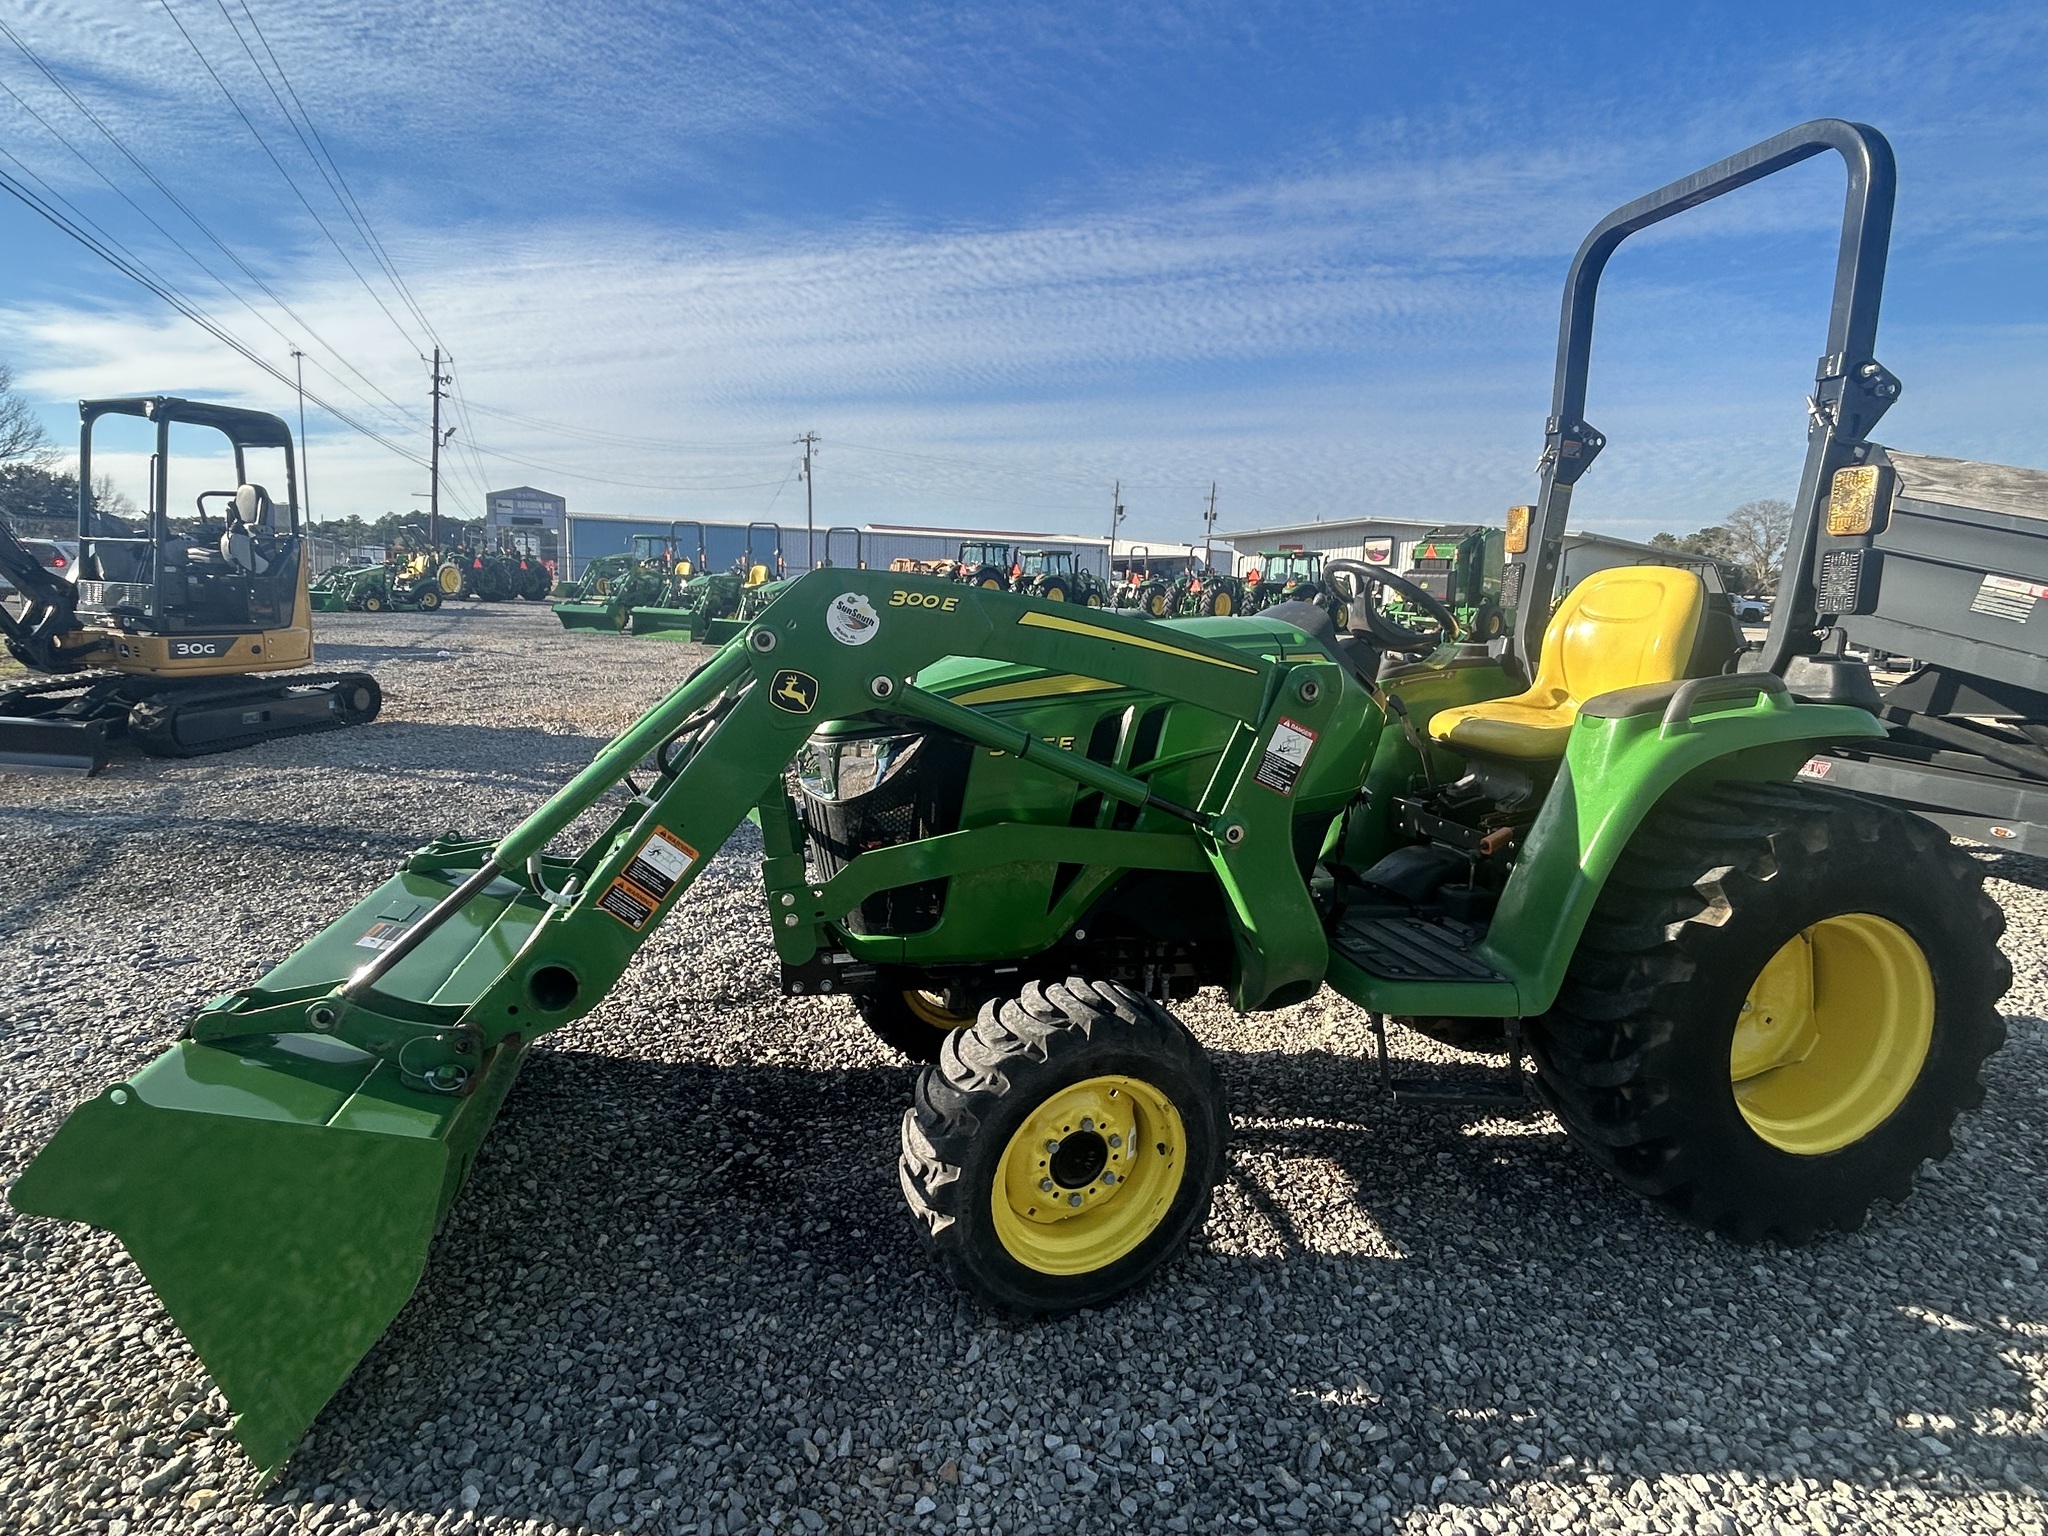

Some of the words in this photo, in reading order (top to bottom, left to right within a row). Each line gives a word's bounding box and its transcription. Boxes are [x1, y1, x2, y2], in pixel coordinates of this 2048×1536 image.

[836, 600, 875, 628] SunSouth
[176, 643, 216, 655] 30G
[1290, 723, 1313, 738] DANGER
[666, 834, 694, 857] WARNING
[625, 886, 654, 907] WARNING
